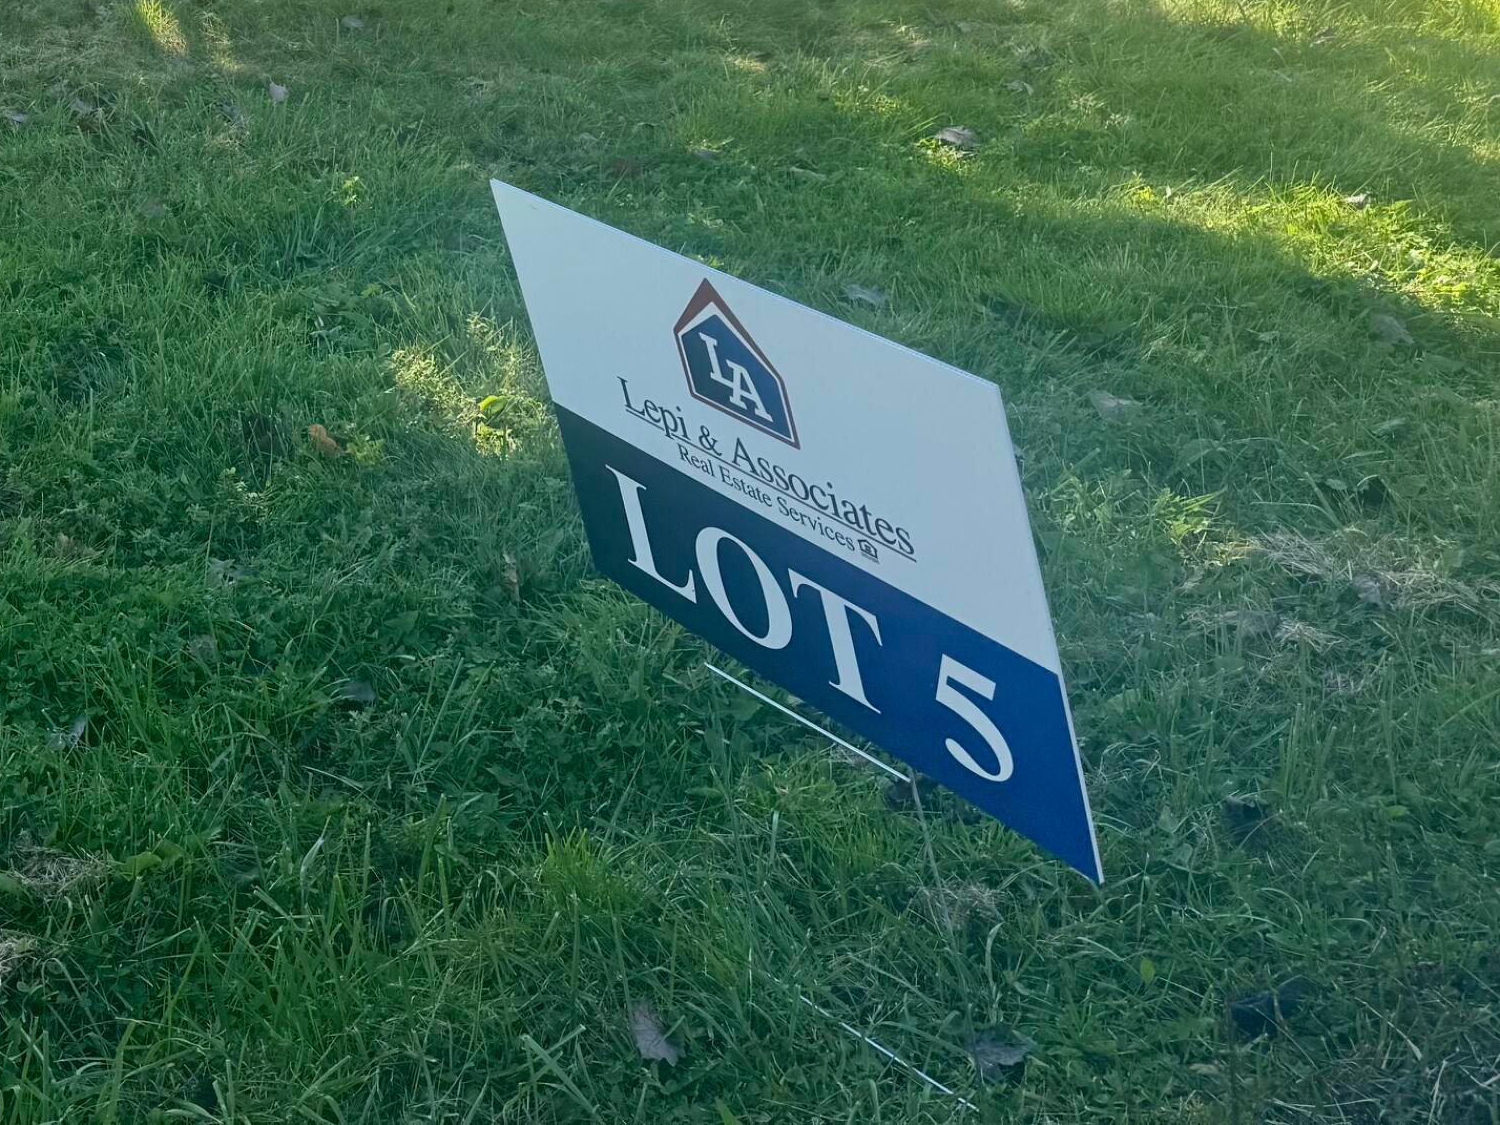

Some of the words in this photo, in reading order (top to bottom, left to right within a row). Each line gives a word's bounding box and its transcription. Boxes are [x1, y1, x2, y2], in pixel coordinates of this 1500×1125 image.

[698, 331, 774, 423] LA
[616, 375, 692, 441] Lepi
[698, 425, 723, 457] &
[731, 437, 915, 556] Associates
[677, 442, 715, 478] Real
[719, 465, 773, 508] Estate
[776, 495, 856, 552] Services
[604, 463, 883, 715] LOT
[934, 652, 1014, 783] 5
